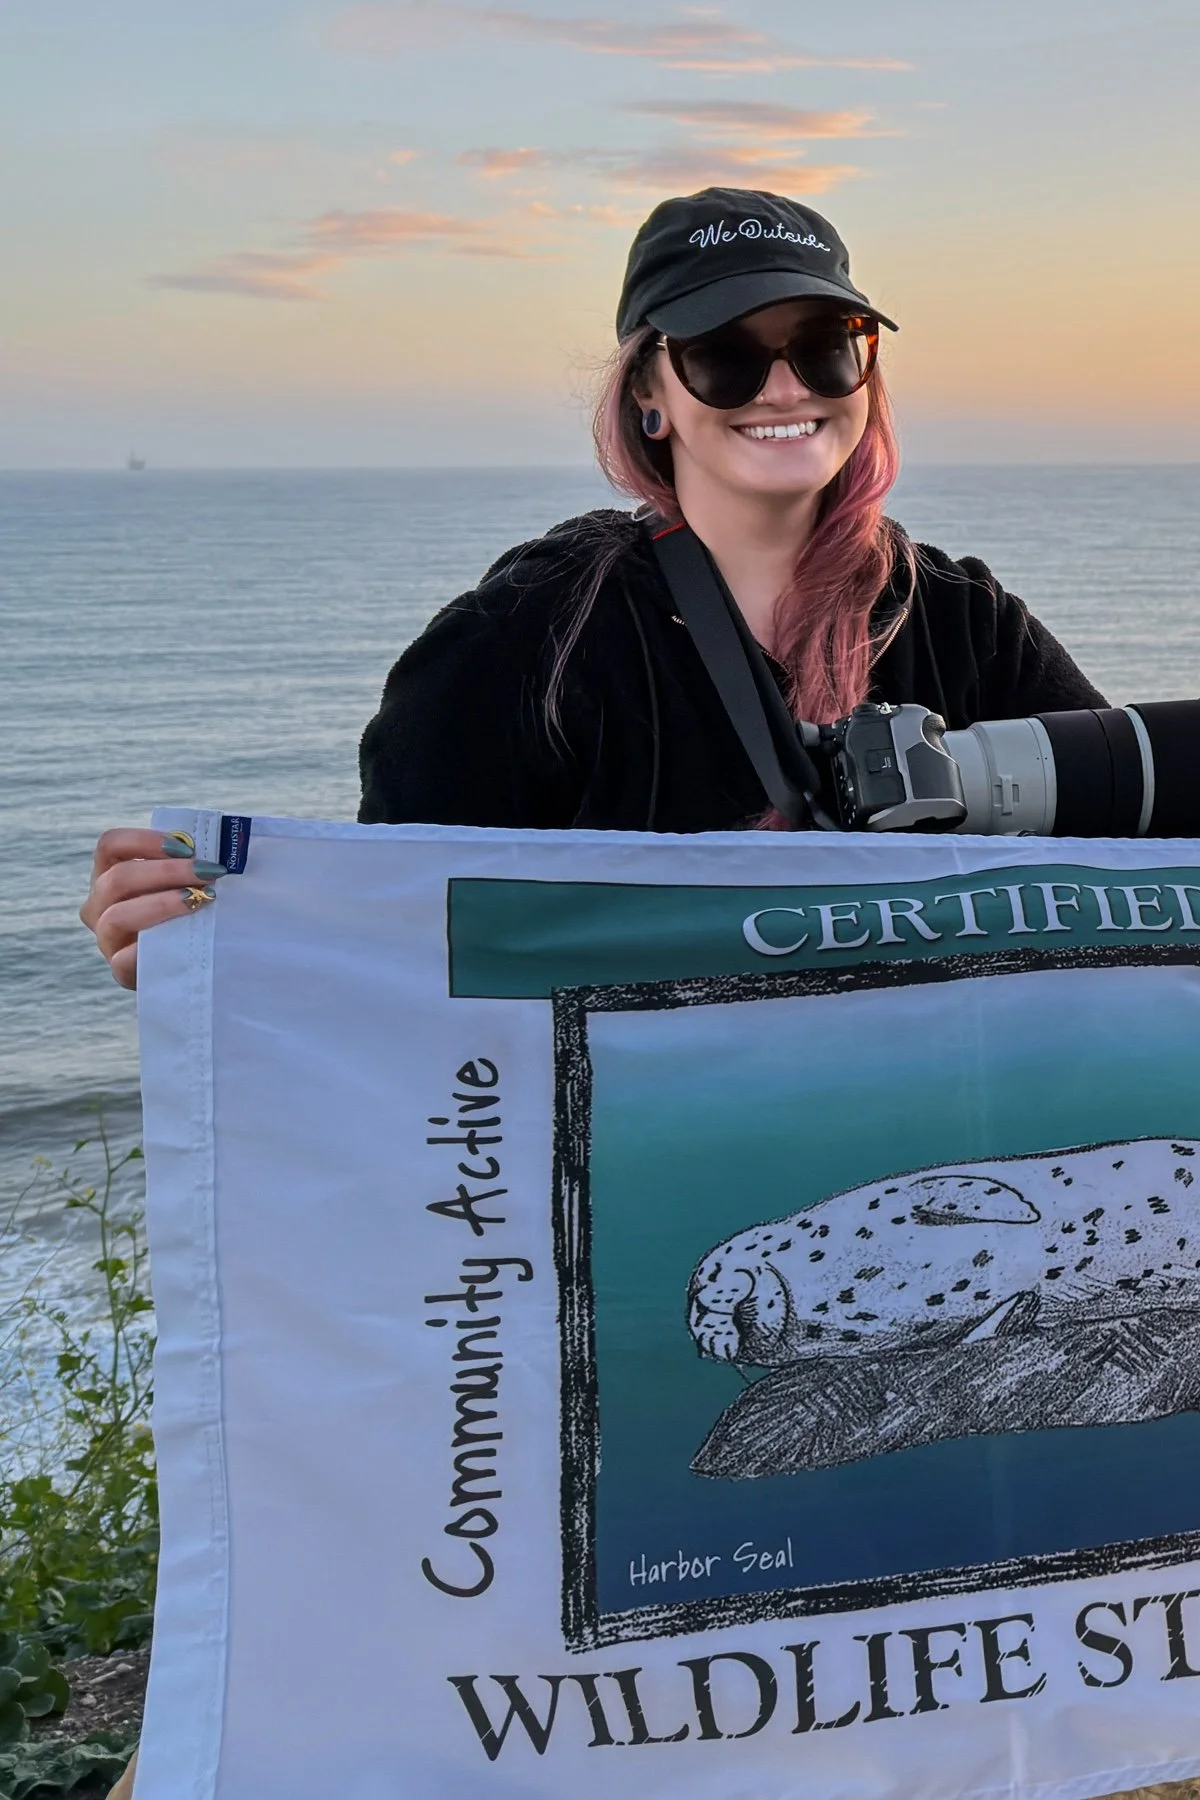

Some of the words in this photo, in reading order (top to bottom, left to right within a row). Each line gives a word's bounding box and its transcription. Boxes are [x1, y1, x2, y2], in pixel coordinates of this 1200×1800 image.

[689, 219, 737, 248] We
[738, 218, 831, 252] Outside
[425, 1057, 508, 1236] Active
[421, 1256, 534, 1599] Community
[629, 1550, 722, 1586] Harbor
[732, 1537, 794, 1573] Seal
[452, 1614, 1047, 1761] WILDLIFE
